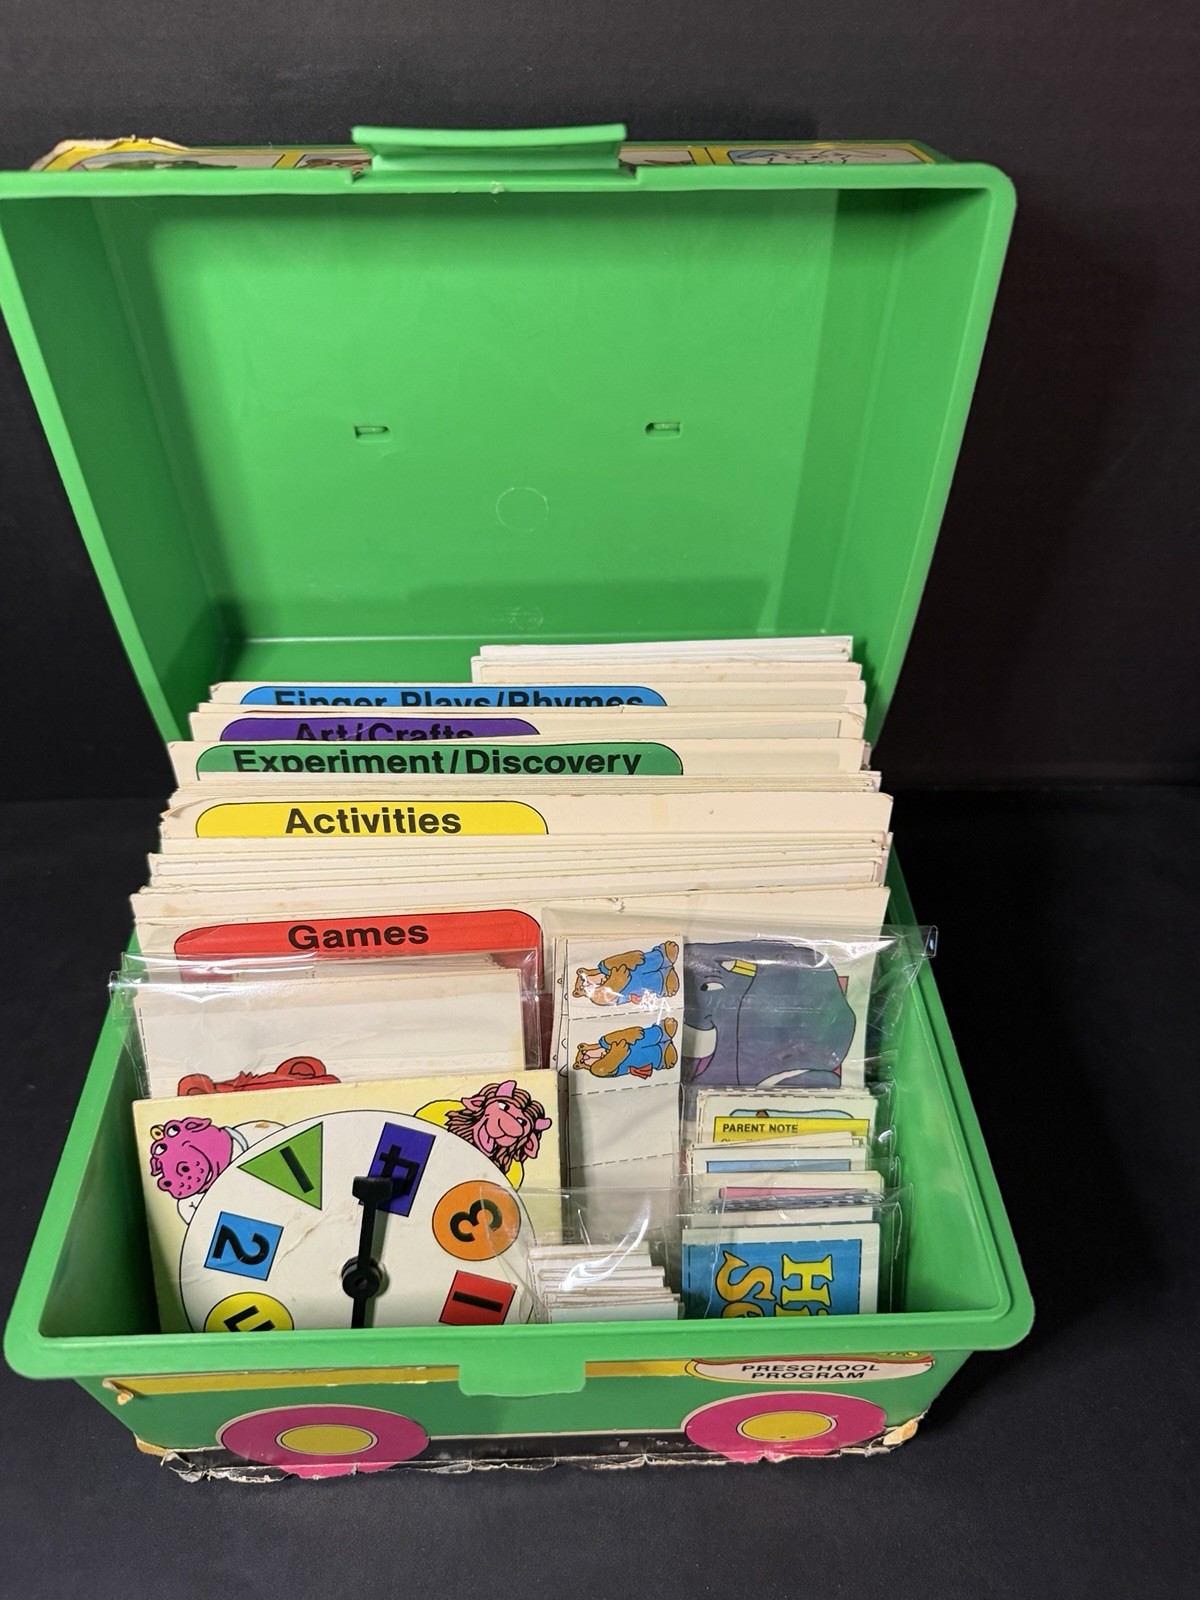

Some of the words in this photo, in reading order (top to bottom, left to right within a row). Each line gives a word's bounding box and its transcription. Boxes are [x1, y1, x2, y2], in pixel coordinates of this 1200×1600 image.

[234, 748, 642, 775] Experiment/Discovery
[285, 807, 462, 834] Activities
[288, 924, 429, 950] Games
[722, 1123, 765, 1133] PARENT
[768, 1124, 798, 1133] NOTE
[450, 1199, 503, 1242] 3
[212, 1224, 270, 1266] 2
[741, 1364, 880, 1372] PRESCHOOL
